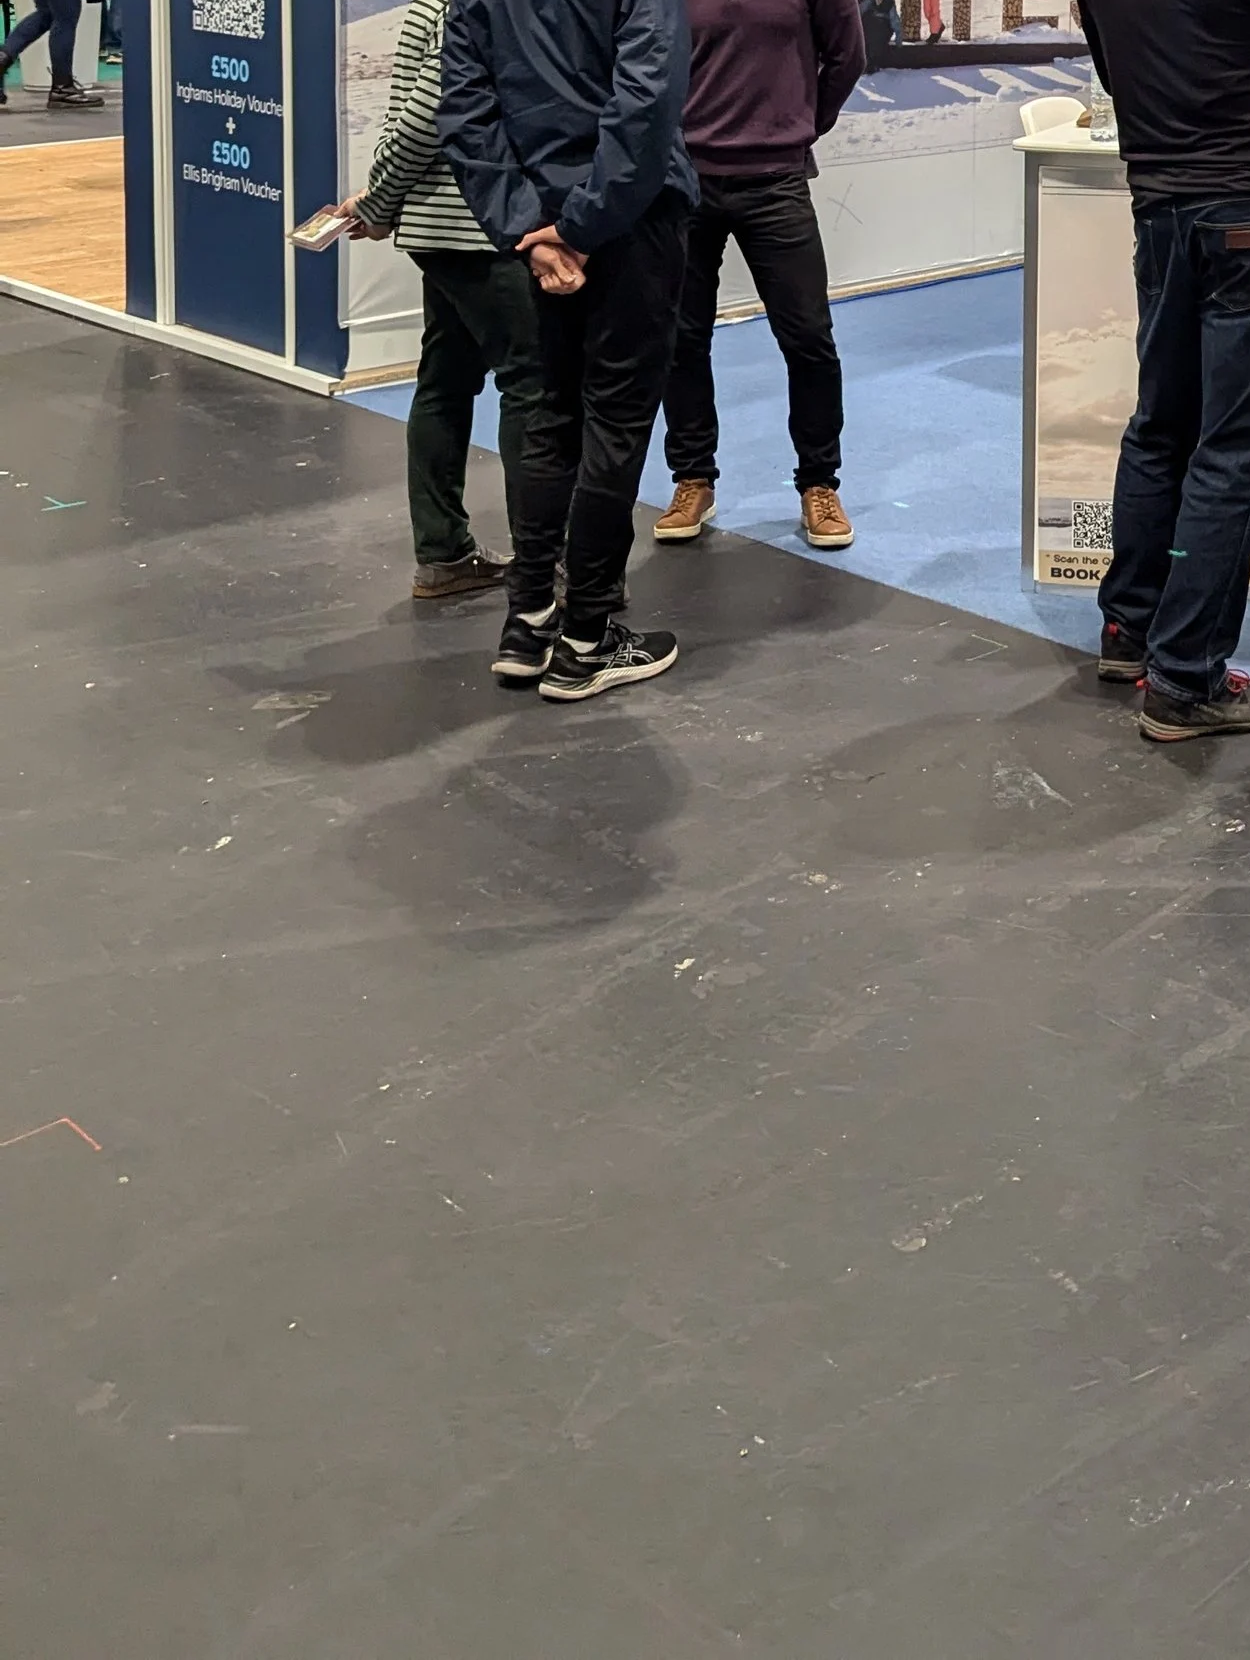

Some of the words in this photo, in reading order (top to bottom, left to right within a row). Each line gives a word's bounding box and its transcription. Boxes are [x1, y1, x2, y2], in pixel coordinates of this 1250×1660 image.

[211, 55, 250, 83] £500
[176, 81, 213, 103] Inghams
[213, 88, 247, 114] Holiday
[247, 94, 284, 117] Vouche
[212, 140, 250, 170] £500
[183, 163, 201, 183] Ellis
[201, 168, 240, 192] Brigham
[241, 177, 282, 202] Voucher
[1050, 567, 1102, 581] BOOK
[1053, 554, 1079, 564] Scan
[1082, 556, 1099, 565] the
